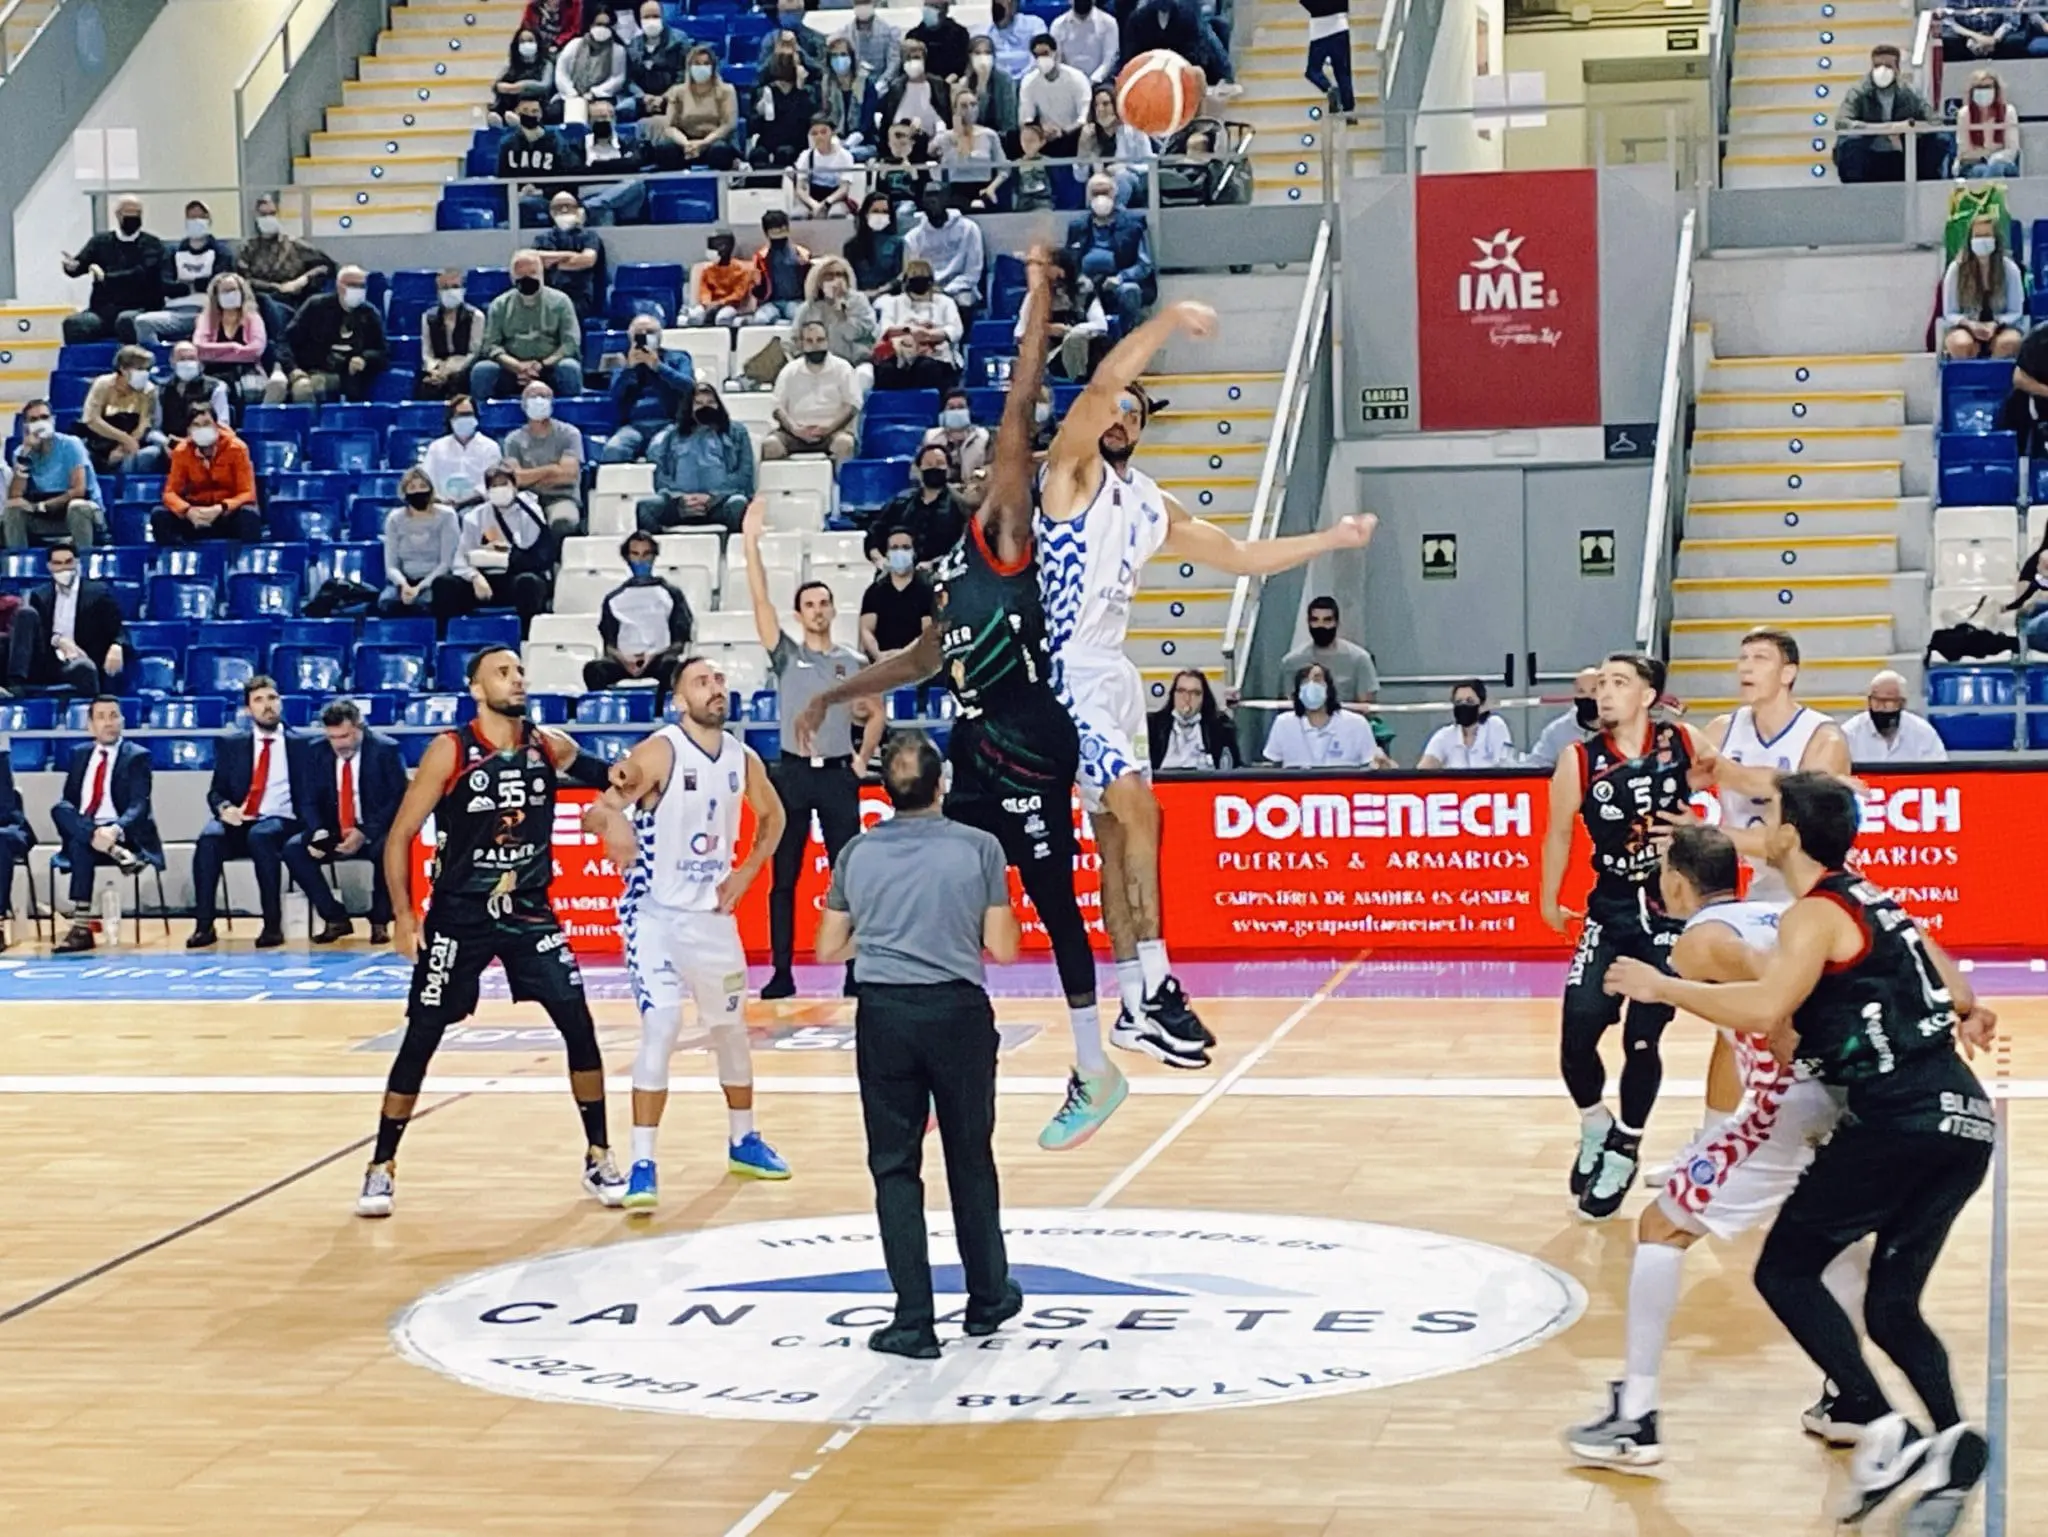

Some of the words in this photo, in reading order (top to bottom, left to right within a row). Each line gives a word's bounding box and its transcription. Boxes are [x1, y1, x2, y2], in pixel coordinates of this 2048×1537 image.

[1459, 272, 1545, 312] IME
[498, 780, 527, 808] 55
[1634, 786, 1653, 817] 5
[1215, 793, 1531, 839] DOMENECH
[1218, 851, 1330, 871] PUERTAS
[1347, 851, 1367, 871] &
[1386, 850, 1531, 870] ARMARIOS
[478, 1302, 758, 1327] CAN
